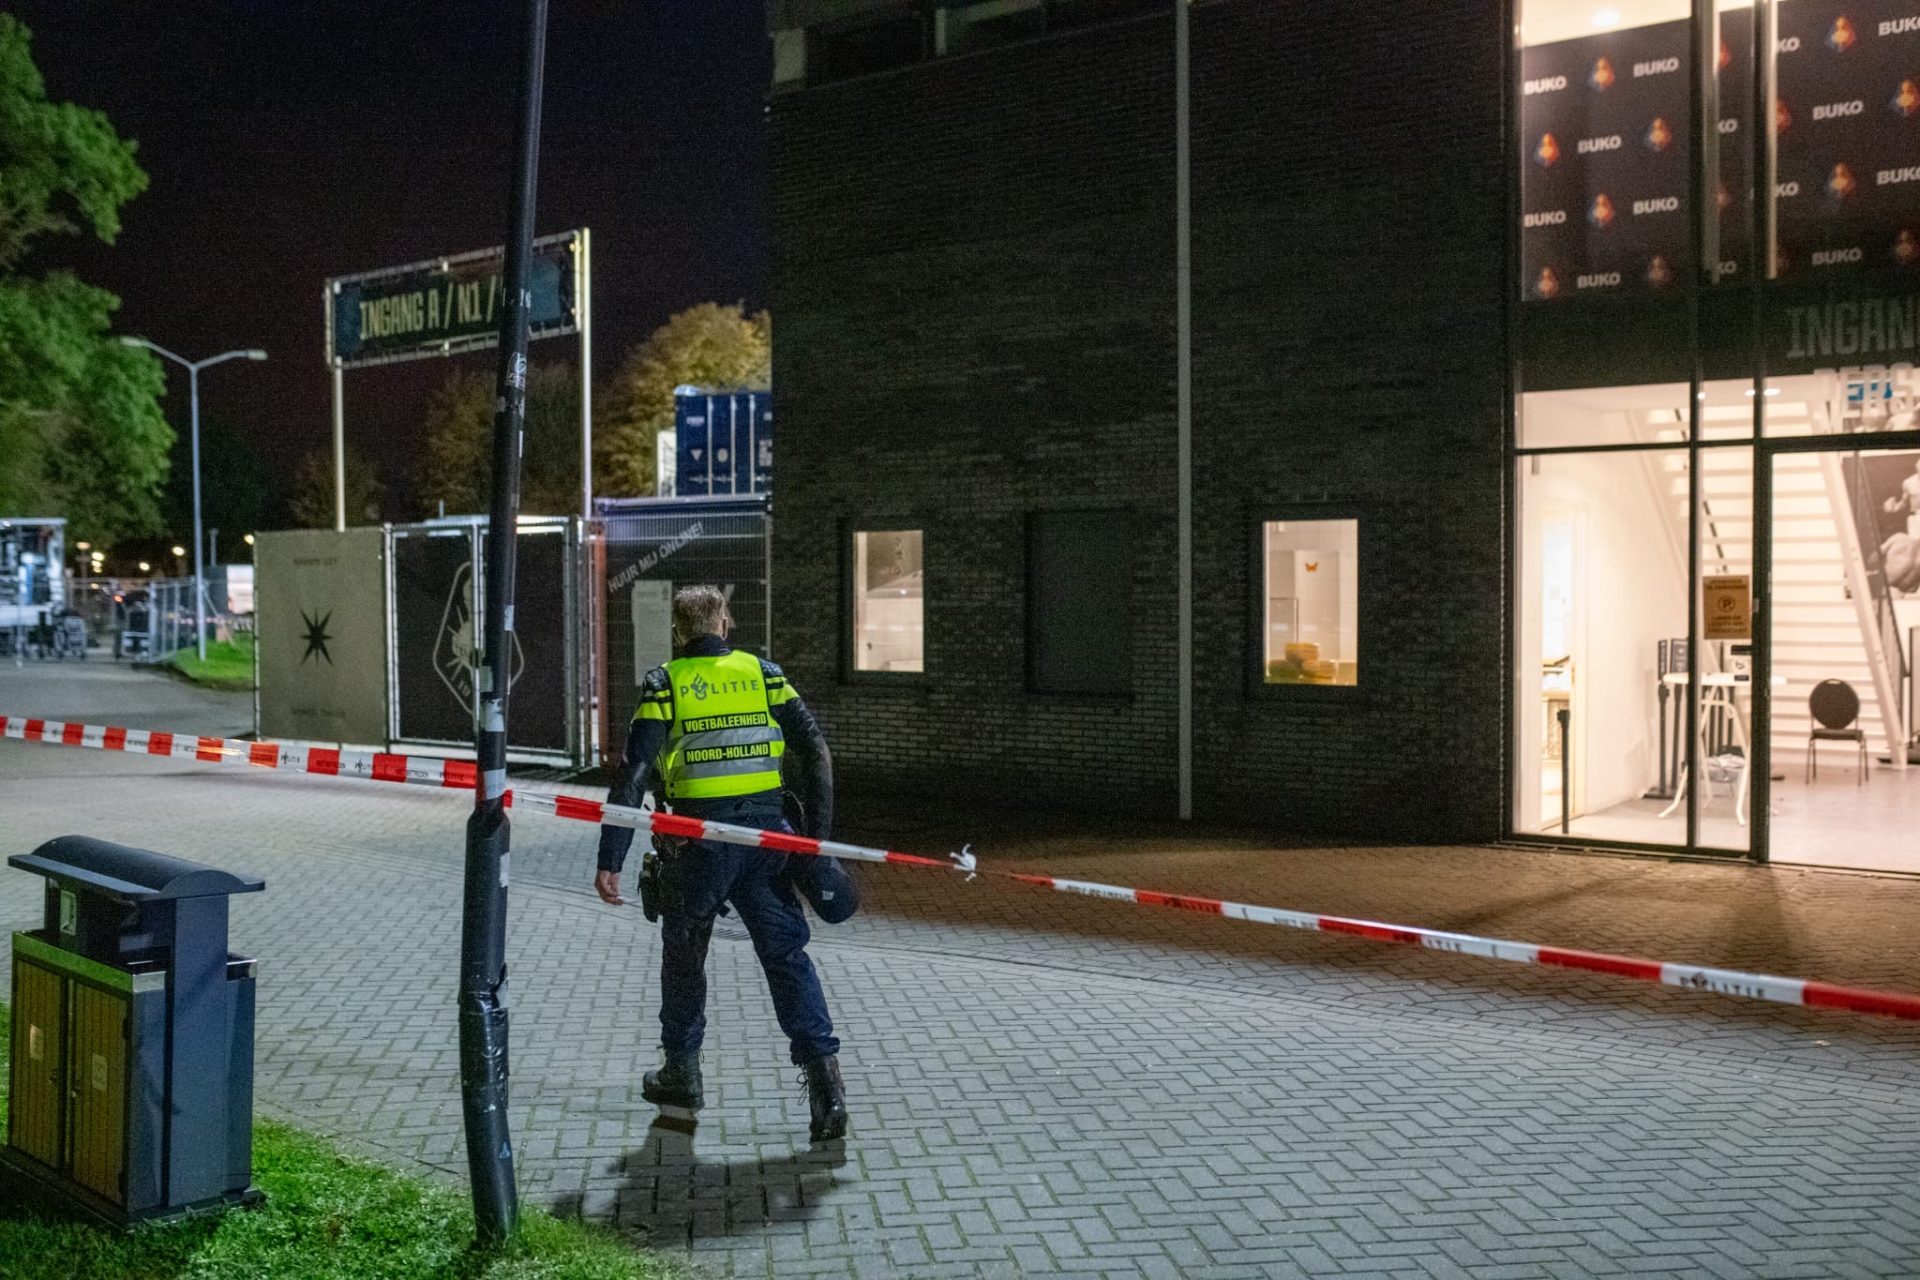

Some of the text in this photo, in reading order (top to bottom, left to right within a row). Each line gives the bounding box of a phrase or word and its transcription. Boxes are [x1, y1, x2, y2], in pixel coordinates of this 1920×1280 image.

[1633, 57, 1680, 77] BUKO
[1524, 75, 1568, 95] BUKO
[1812, 100, 1864, 120] BUKO
[1578, 135, 1622, 154] BUKO
[1632, 196, 1679, 215] BUKO
[1523, 210, 1567, 228] BUKO
[1811, 247, 1863, 267] BUKO
[1577, 271, 1621, 289] BUKO
[360, 290, 424, 340] INGANG
[428, 287, 440, 330] A
[680, 673, 760, 700] POLITIE
[685, 713, 767, 732] VOETBALEENHEID
[686, 743, 769, 763] NOORD-HOLLAND
